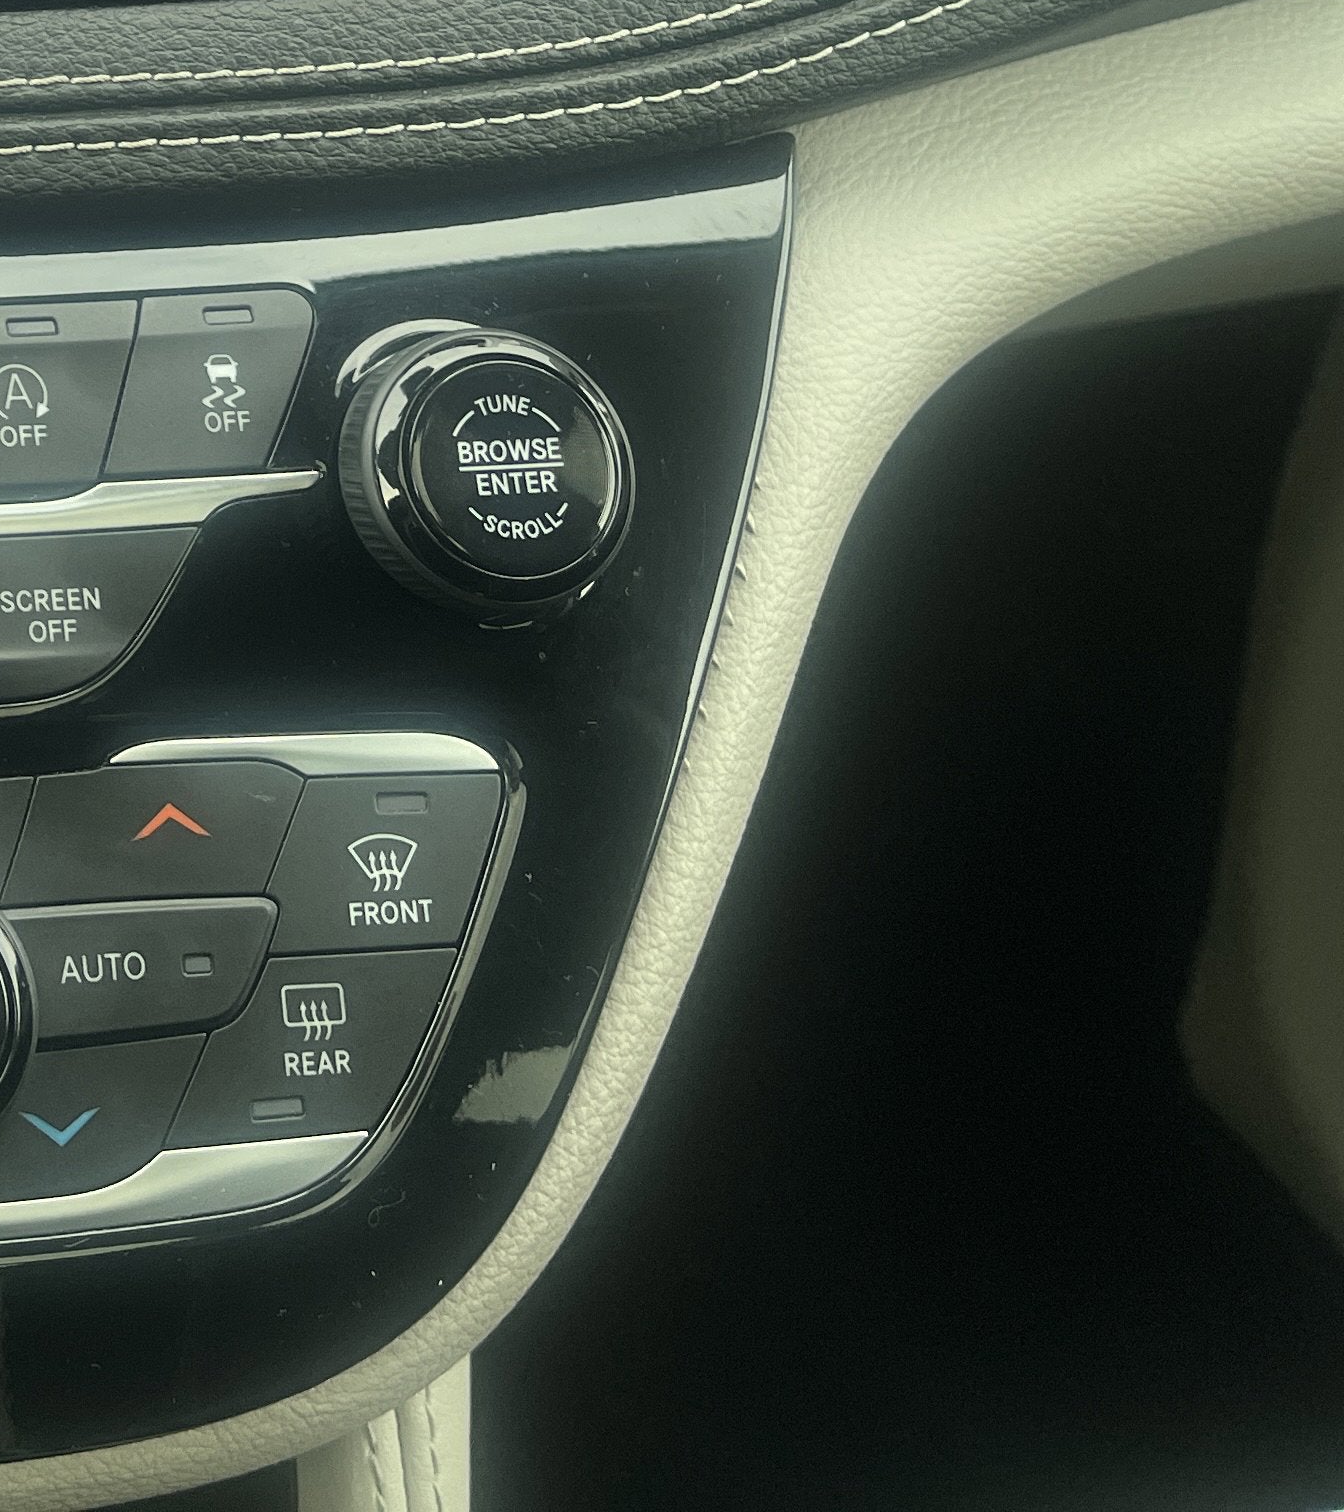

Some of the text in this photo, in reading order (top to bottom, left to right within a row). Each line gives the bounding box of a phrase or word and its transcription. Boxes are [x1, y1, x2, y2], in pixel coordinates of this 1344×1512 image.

[473, 393, 532, 417] TUNE
[0, 423, 48, 448] OFF
[203, 410, 251, 434] OFF
[456, 436, 563, 465] BROWSE
[474, 469, 559, 497] ENTER
[482, 511, 565, 540] SCROLL
[0, 586, 102, 613] SCREEN
[28, 618, 78, 644] OFF
[347, 898, 433, 928] FRONT
[60, 952, 147, 985] AUTO
[283, 1050, 352, 1077] REAR
